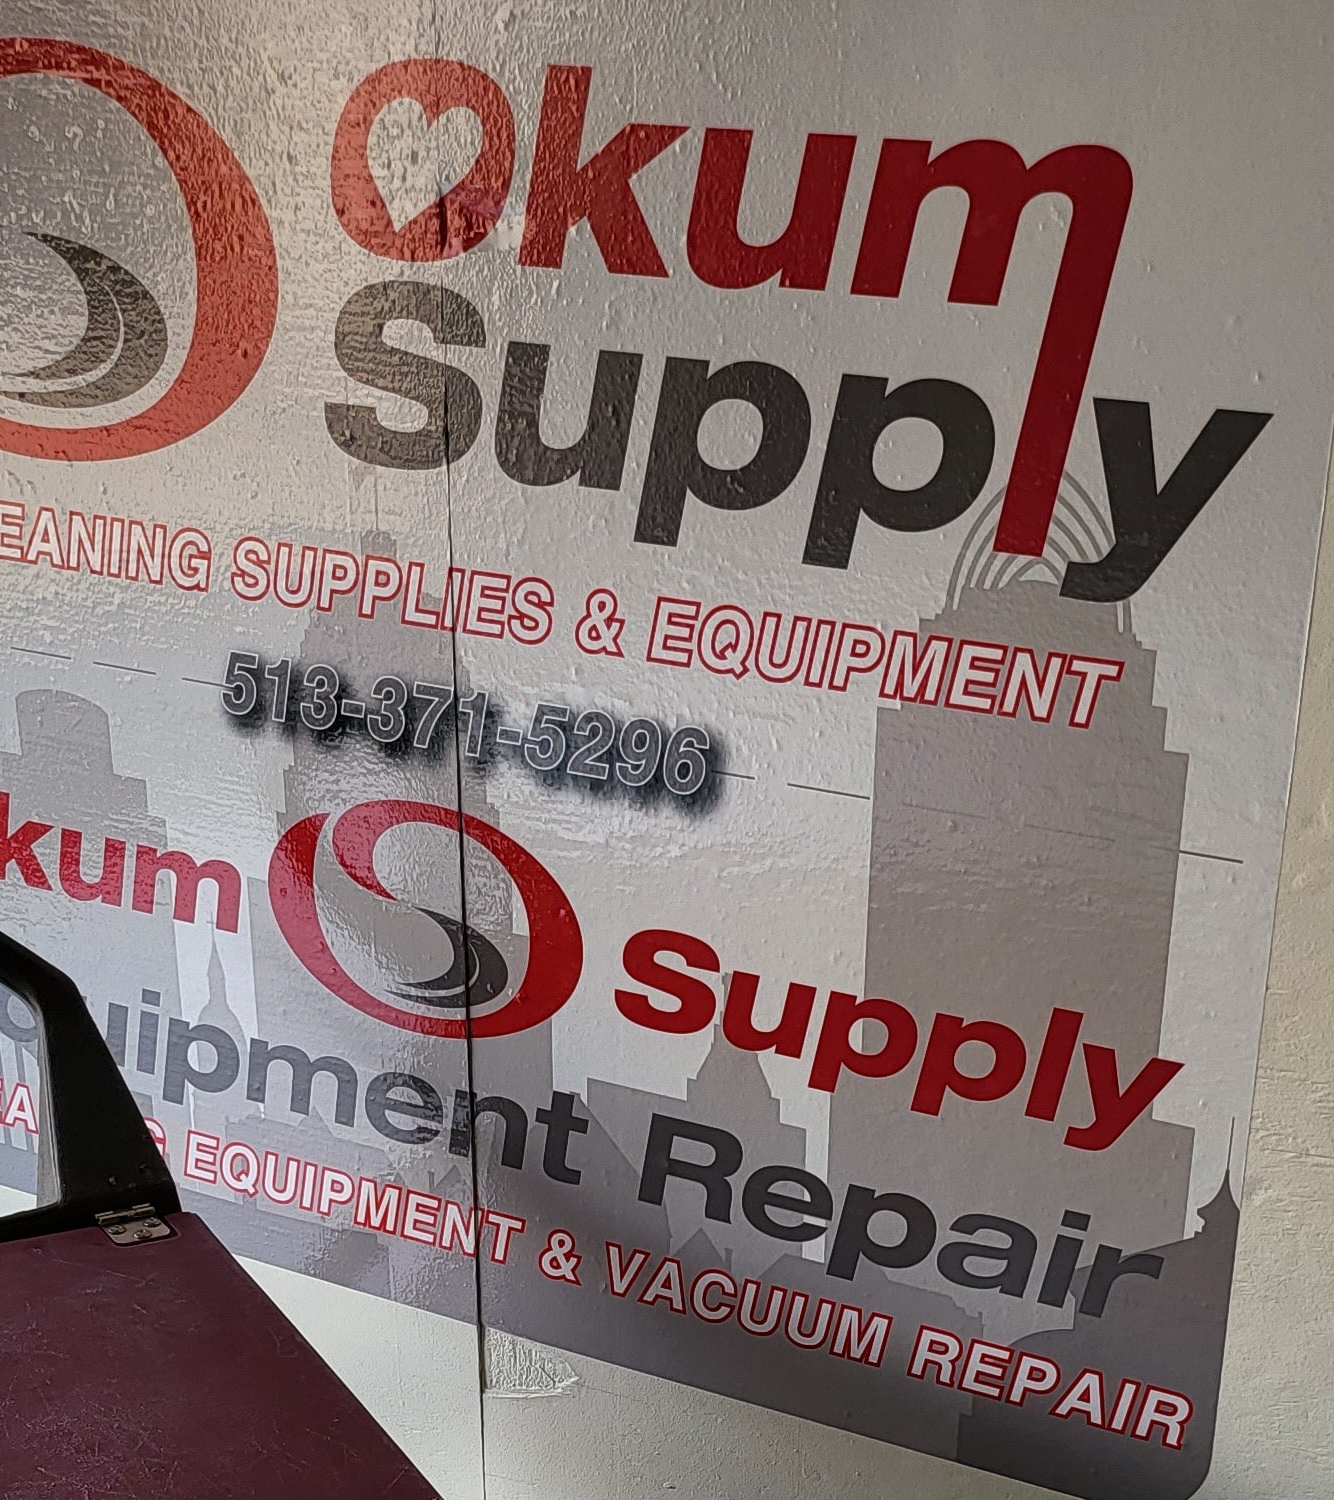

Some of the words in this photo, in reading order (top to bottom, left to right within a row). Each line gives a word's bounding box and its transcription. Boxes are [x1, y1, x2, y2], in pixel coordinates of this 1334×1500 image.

[330, 57, 1134, 308] Okum
[323, 279, 1275, 604] Supply
[221, 650, 711, 796] 513-371-5296
[230, 535, 555, 646] SUPPLIES
[575, 588, 625, 657] &
[646, 596, 1125, 730] EQUIPMENT
[613, 928, 1186, 1152] Supply
[183, 1128, 526, 1265] EQUIPMENT
[538, 1228, 583, 1287] &
[603, 1240, 894, 1368] VACUUM
[906, 1323, 1195, 1451] REPAIR
[637, 1111, 1166, 1319] Repair
